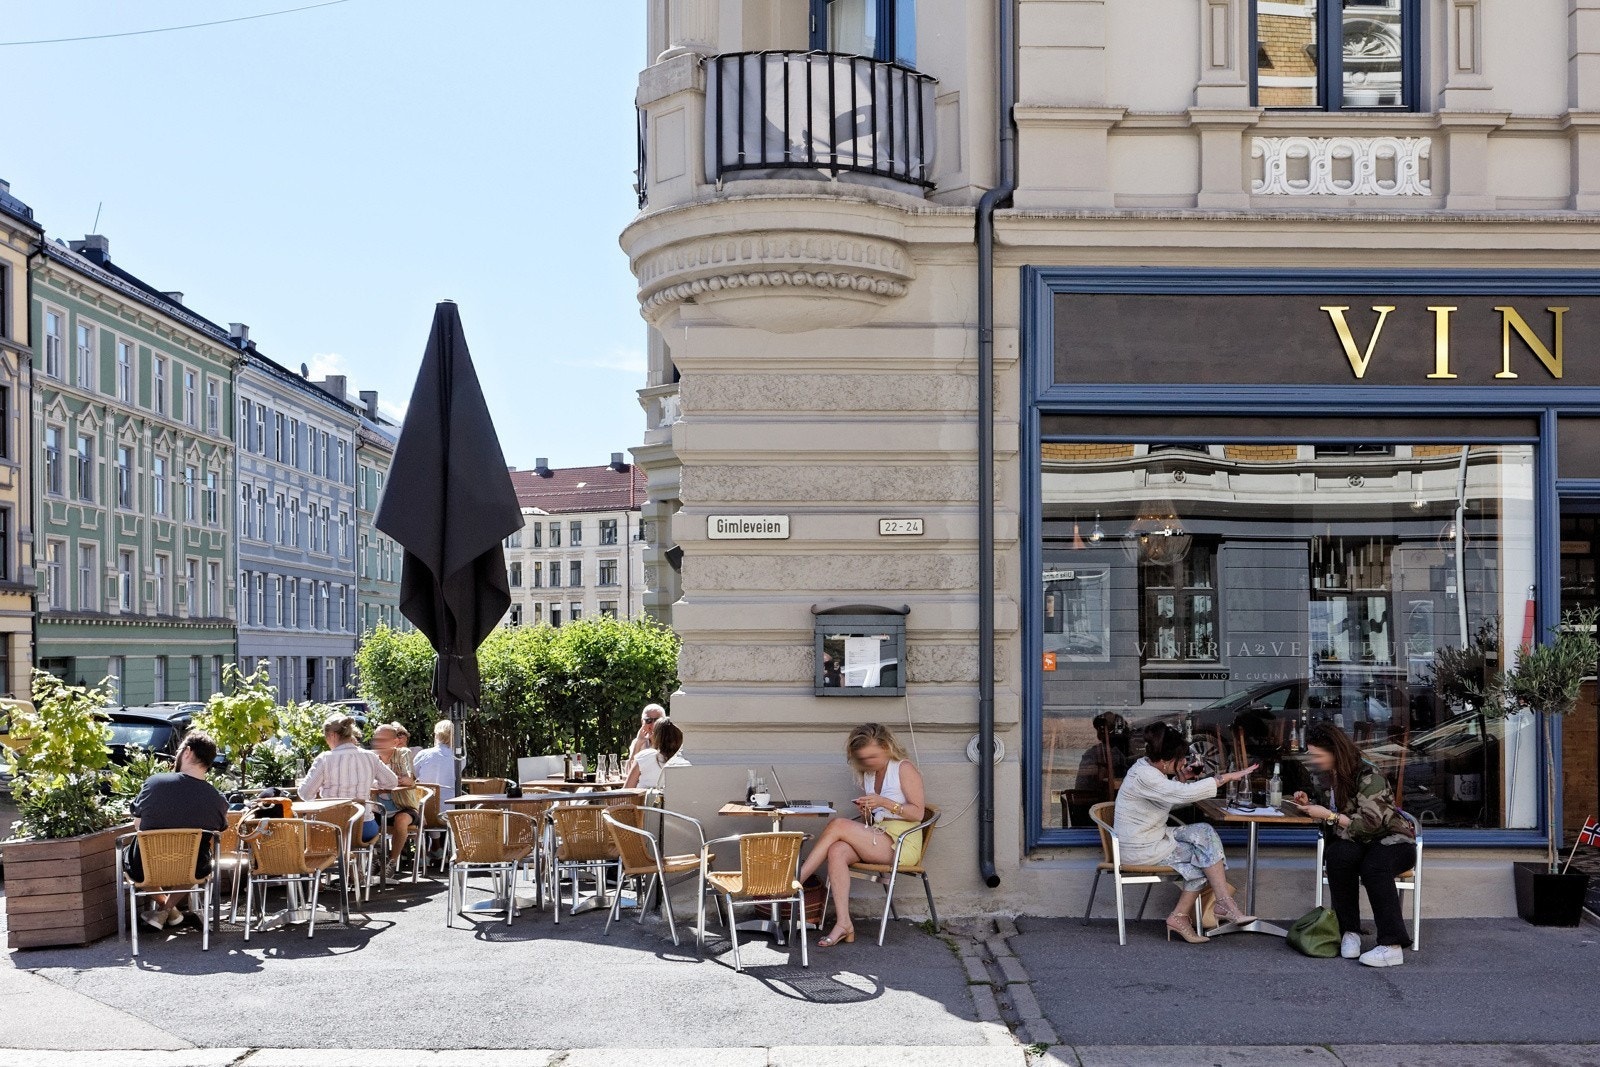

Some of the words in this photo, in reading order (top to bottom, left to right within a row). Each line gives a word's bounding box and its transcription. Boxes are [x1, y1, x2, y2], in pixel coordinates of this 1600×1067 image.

[1319, 305, 1570, 379] VIN
[716, 518, 781, 534] Gimleveien
[1133, 641, 1253, 657] VINERIA
